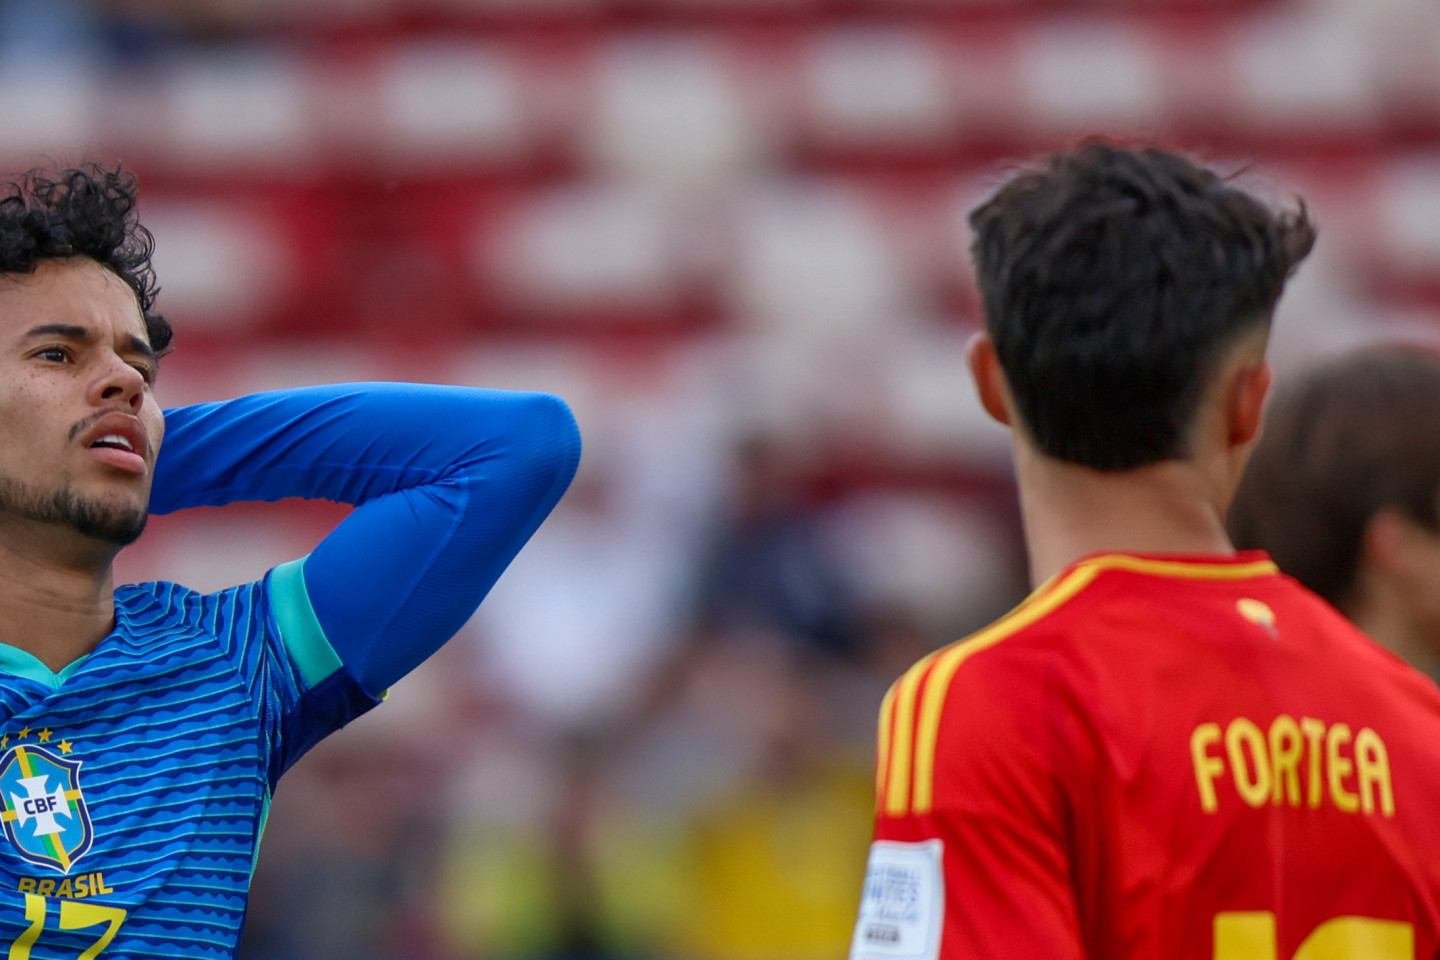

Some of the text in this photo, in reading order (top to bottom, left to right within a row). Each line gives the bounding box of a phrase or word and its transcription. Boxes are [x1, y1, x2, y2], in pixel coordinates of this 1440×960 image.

[1190, 714, 1396, 817] FORTEA
[23, 796, 57, 815] CBF
[18, 872, 114, 899] BRASIL
